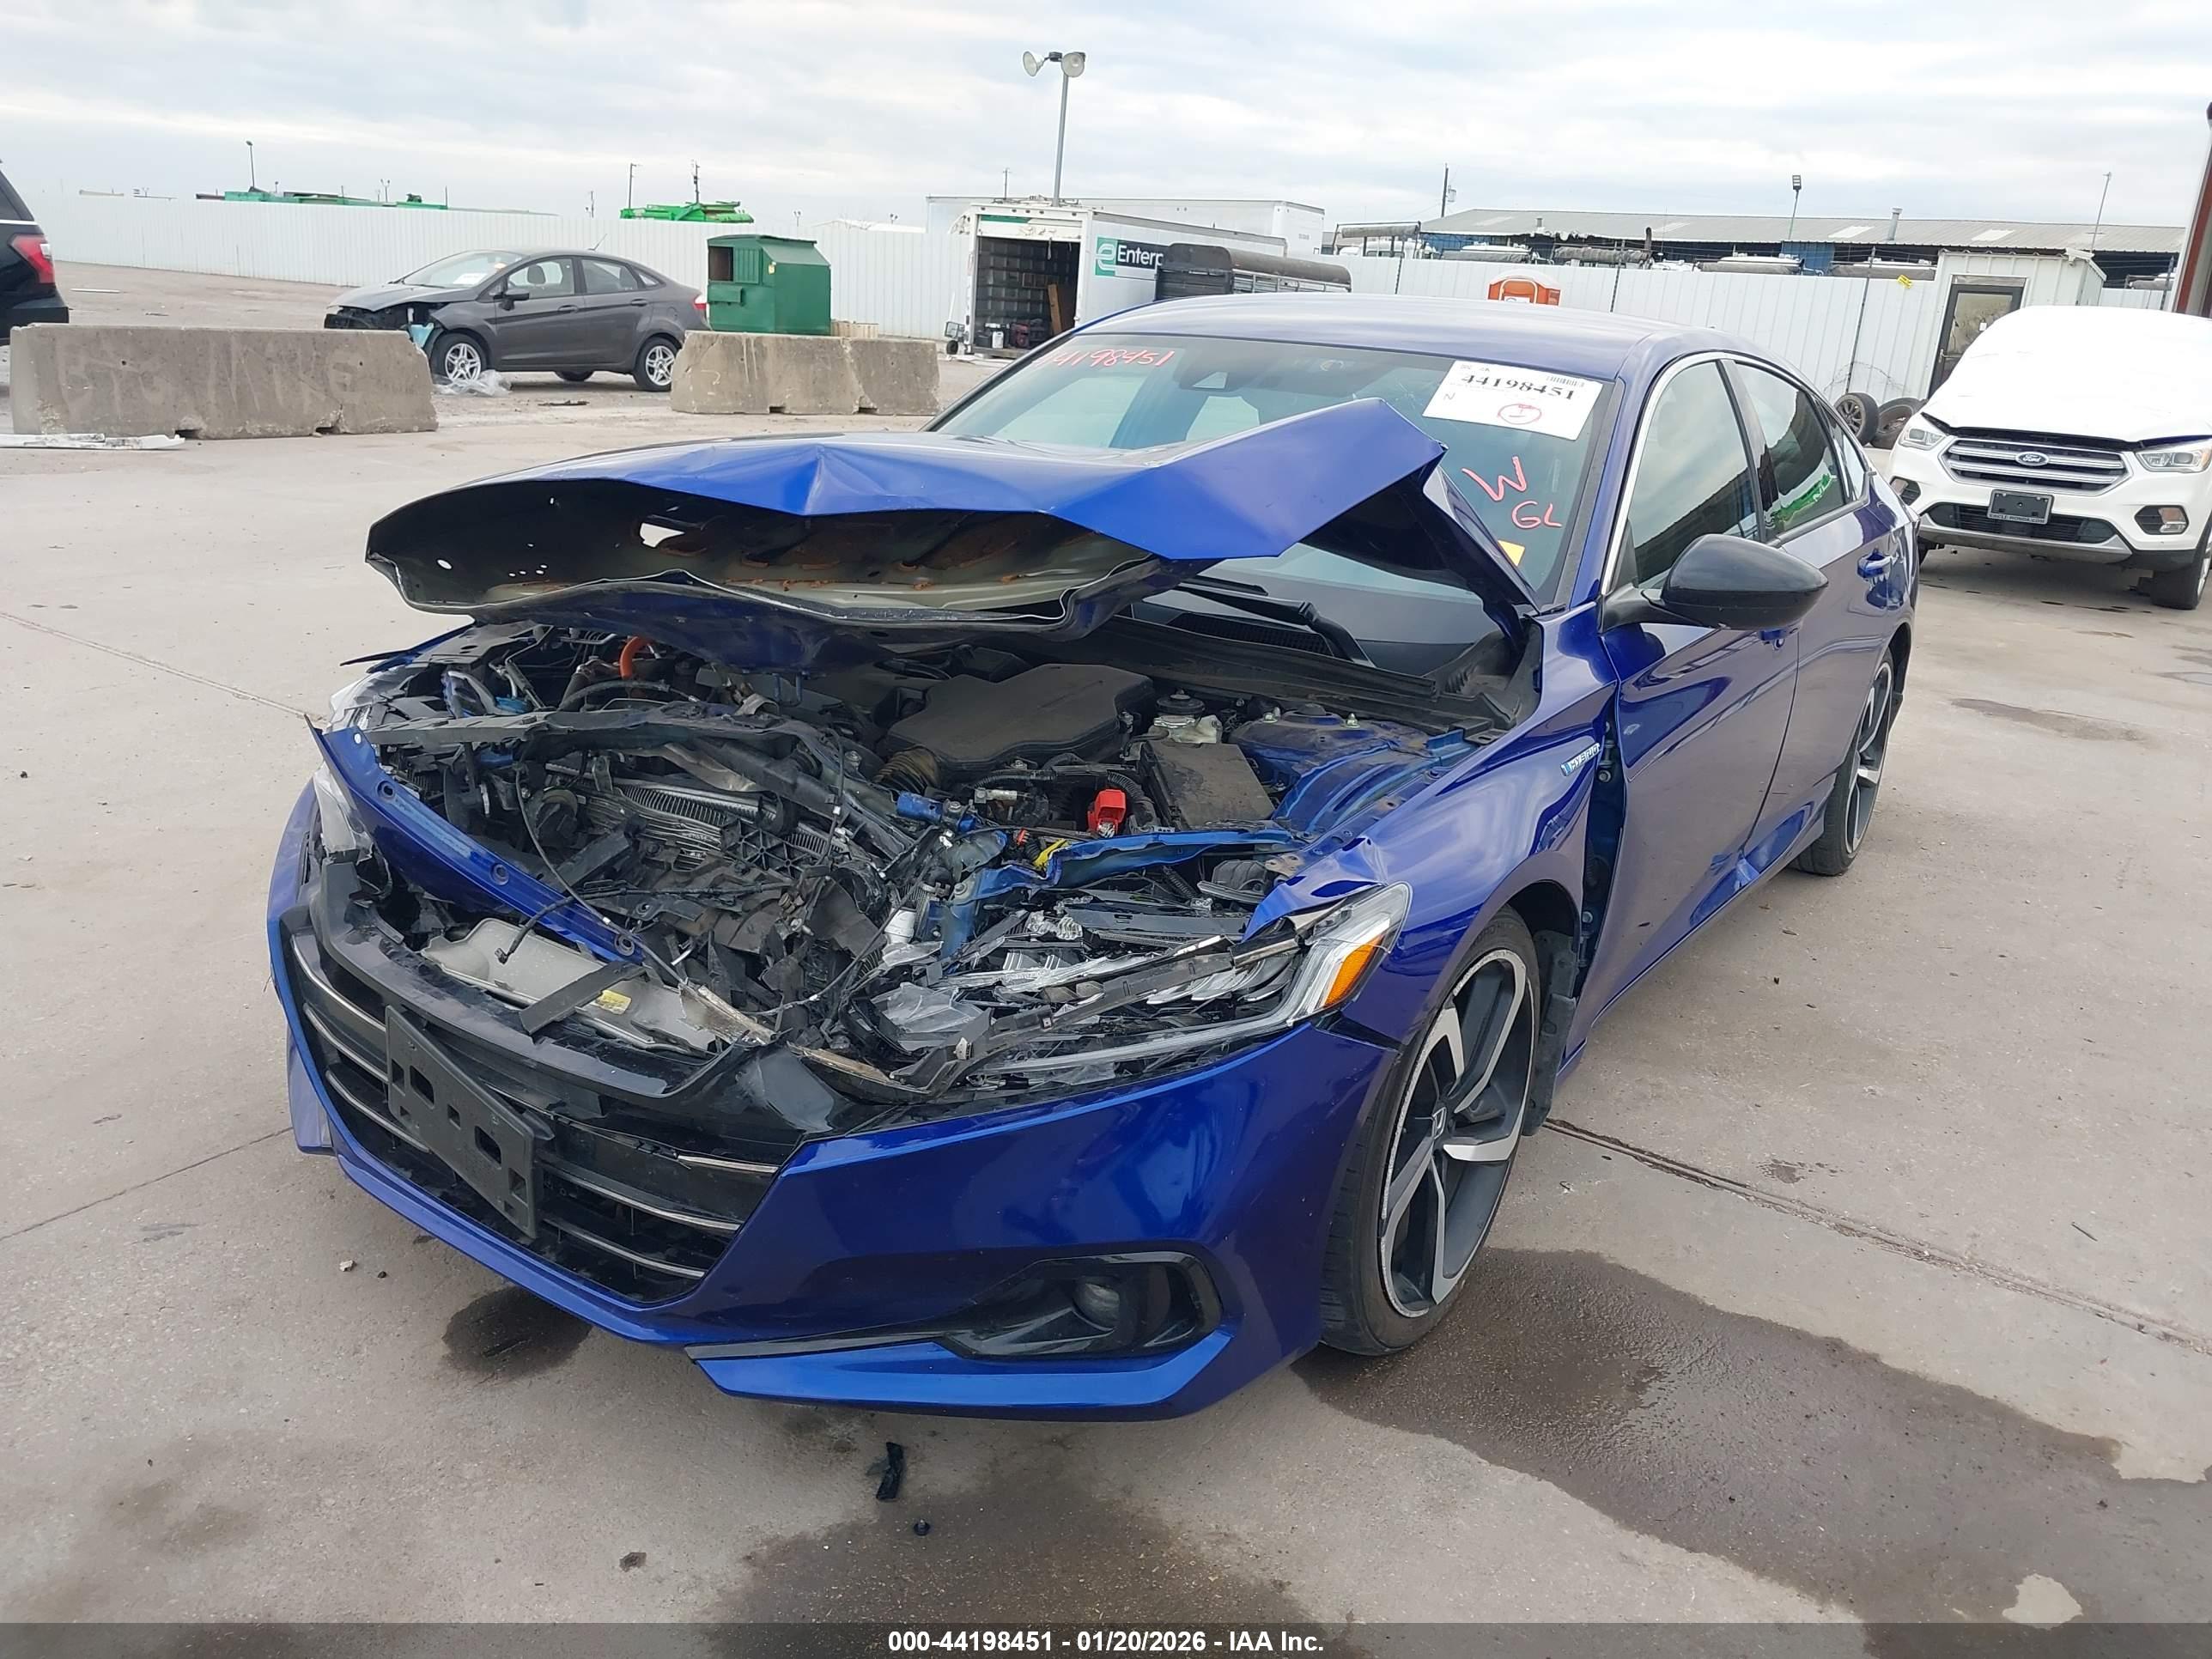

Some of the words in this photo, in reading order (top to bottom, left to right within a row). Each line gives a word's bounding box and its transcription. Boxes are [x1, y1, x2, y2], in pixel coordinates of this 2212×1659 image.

[1461, 374, 1575, 400] 44198451
[1462, 456, 1528, 501] W
[1511, 500, 1563, 531] GL
